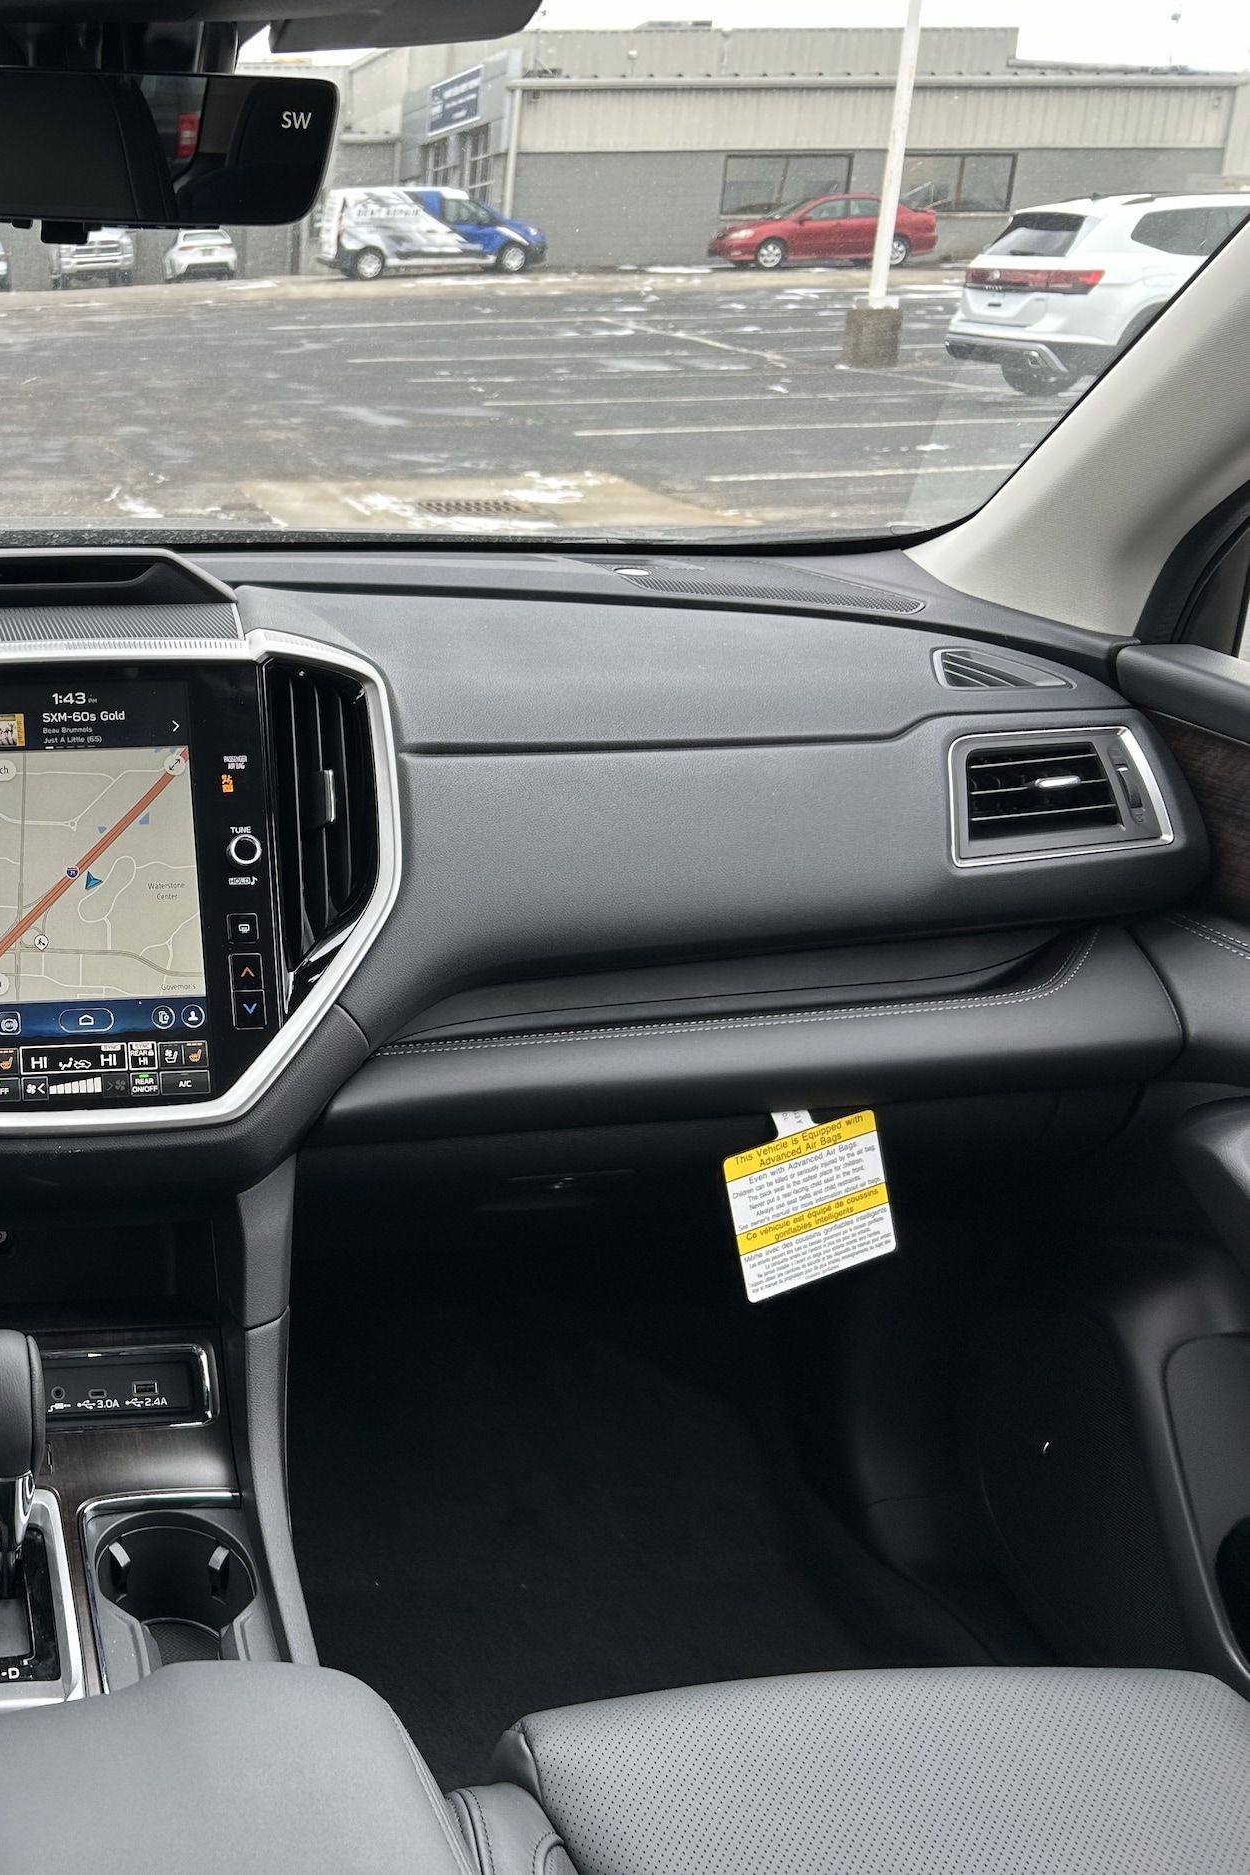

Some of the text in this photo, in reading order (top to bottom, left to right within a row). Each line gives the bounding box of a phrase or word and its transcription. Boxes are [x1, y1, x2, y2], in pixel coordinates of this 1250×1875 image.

[281, 111, 312, 130] SW
[52, 692, 86, 705] 1:43
[42, 710, 125, 723] SXM-60s Gold
[87, 735, 103, 744] (65)
[230, 826, 252, 834] TUNE
[148, 882, 185, 890] Waterstone
[161, 983, 197, 991] Governor's
[31, 1056, 48, 1069] HI
[100, 1054, 117, 1066] HI
[138, 1057, 149, 1066] HI
[132, 1085, 158, 1093] ON/OFF
[179, 1080, 192, 1088] A/C
[734, 1113, 863, 1165] This Vehicle is Equipped with
[758, 1130, 842, 1167] Advanced Air Bags
[748, 1139, 857, 1184] Even with Advanced Air Bags
[745, 1187, 878, 1241] Ce véhicule est équipé de coussins
[773, 1204, 854, 1241] gonflables intelligents
[97, 1397, 168, 1409] 3.0A 2.4A
